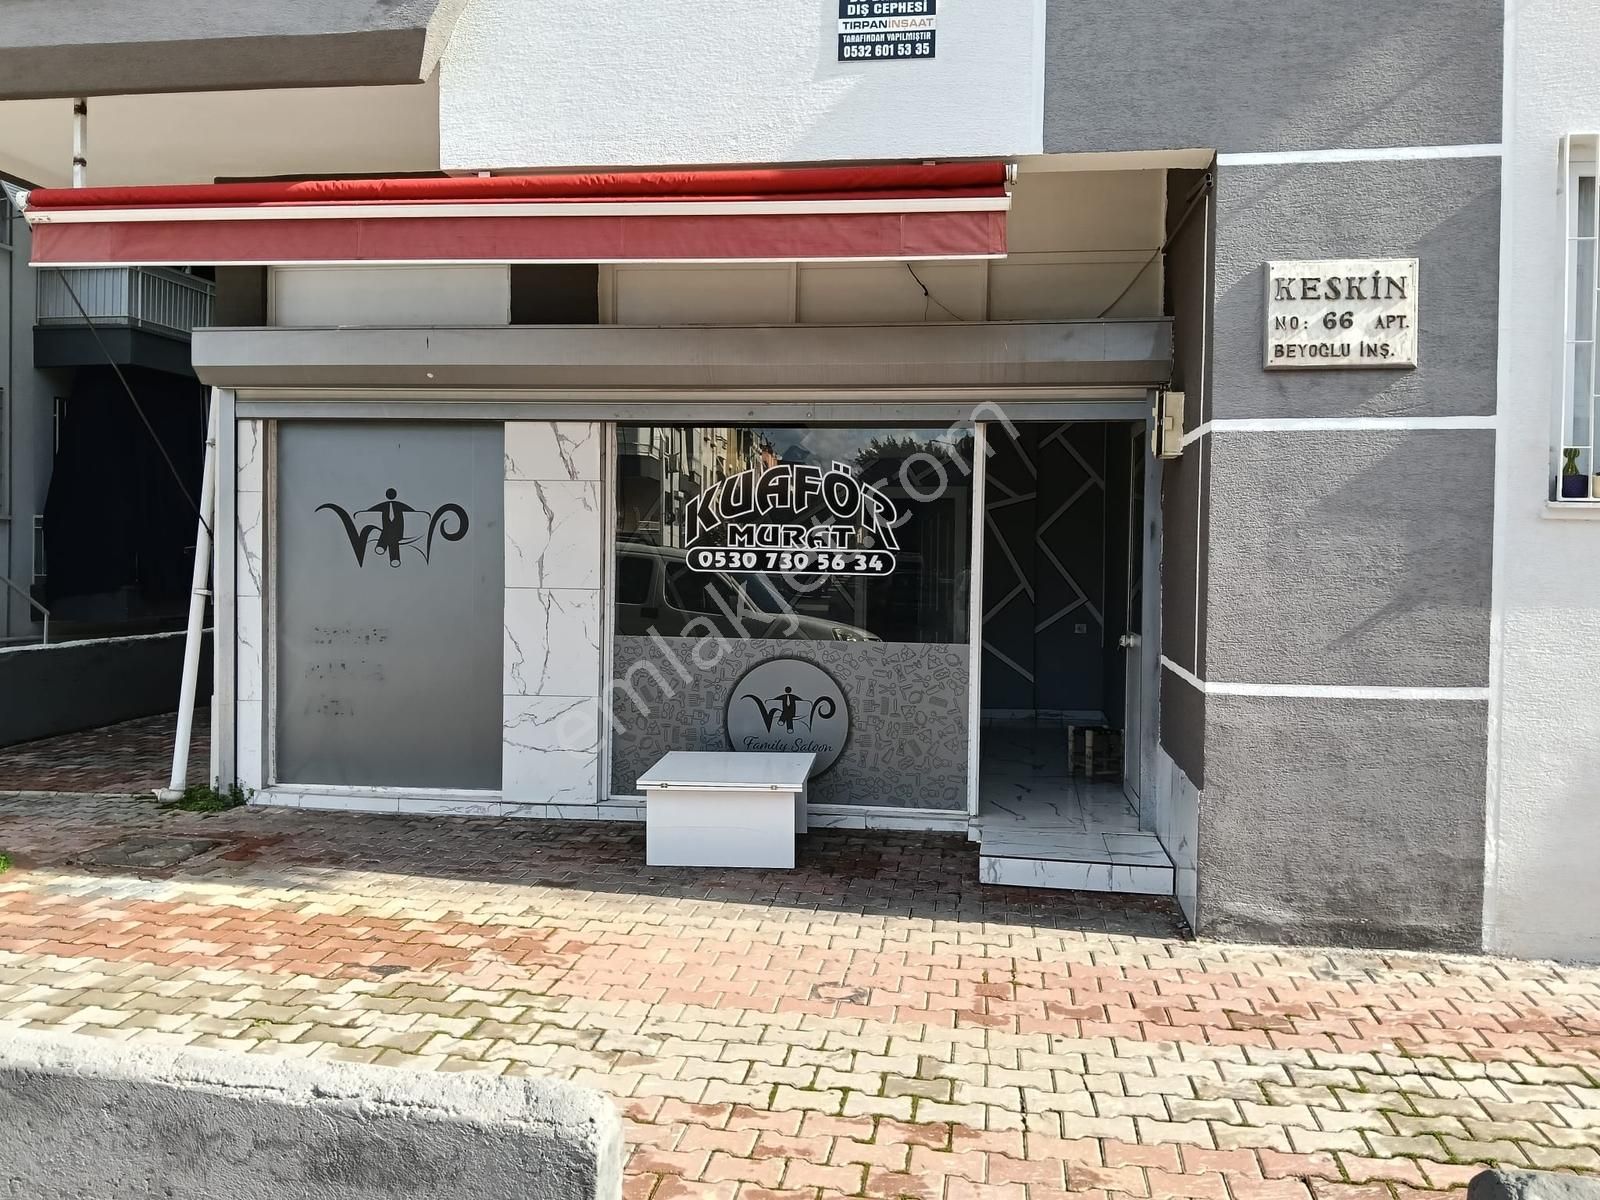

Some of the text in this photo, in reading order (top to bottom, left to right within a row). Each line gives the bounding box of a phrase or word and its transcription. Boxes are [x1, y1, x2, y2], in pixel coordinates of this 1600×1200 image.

[847, 4, 869, 16] DIŞ
[842, 34, 885, 43] TARAFINDAN
[843, 42, 930, 58] 0532 601 53 35
[1274, 270, 1408, 300] KESKİN
[1275, 311, 1410, 330] NO: 66 APT.
[1360, 340, 1395, 359] İNŞ.
[684, 460, 900, 550] KUAFÖR
[727, 523, 856, 549] MURAT
[698, 552, 884, 571] 0530 730 56 34
[743, 735, 834, 752] Family Saloon
